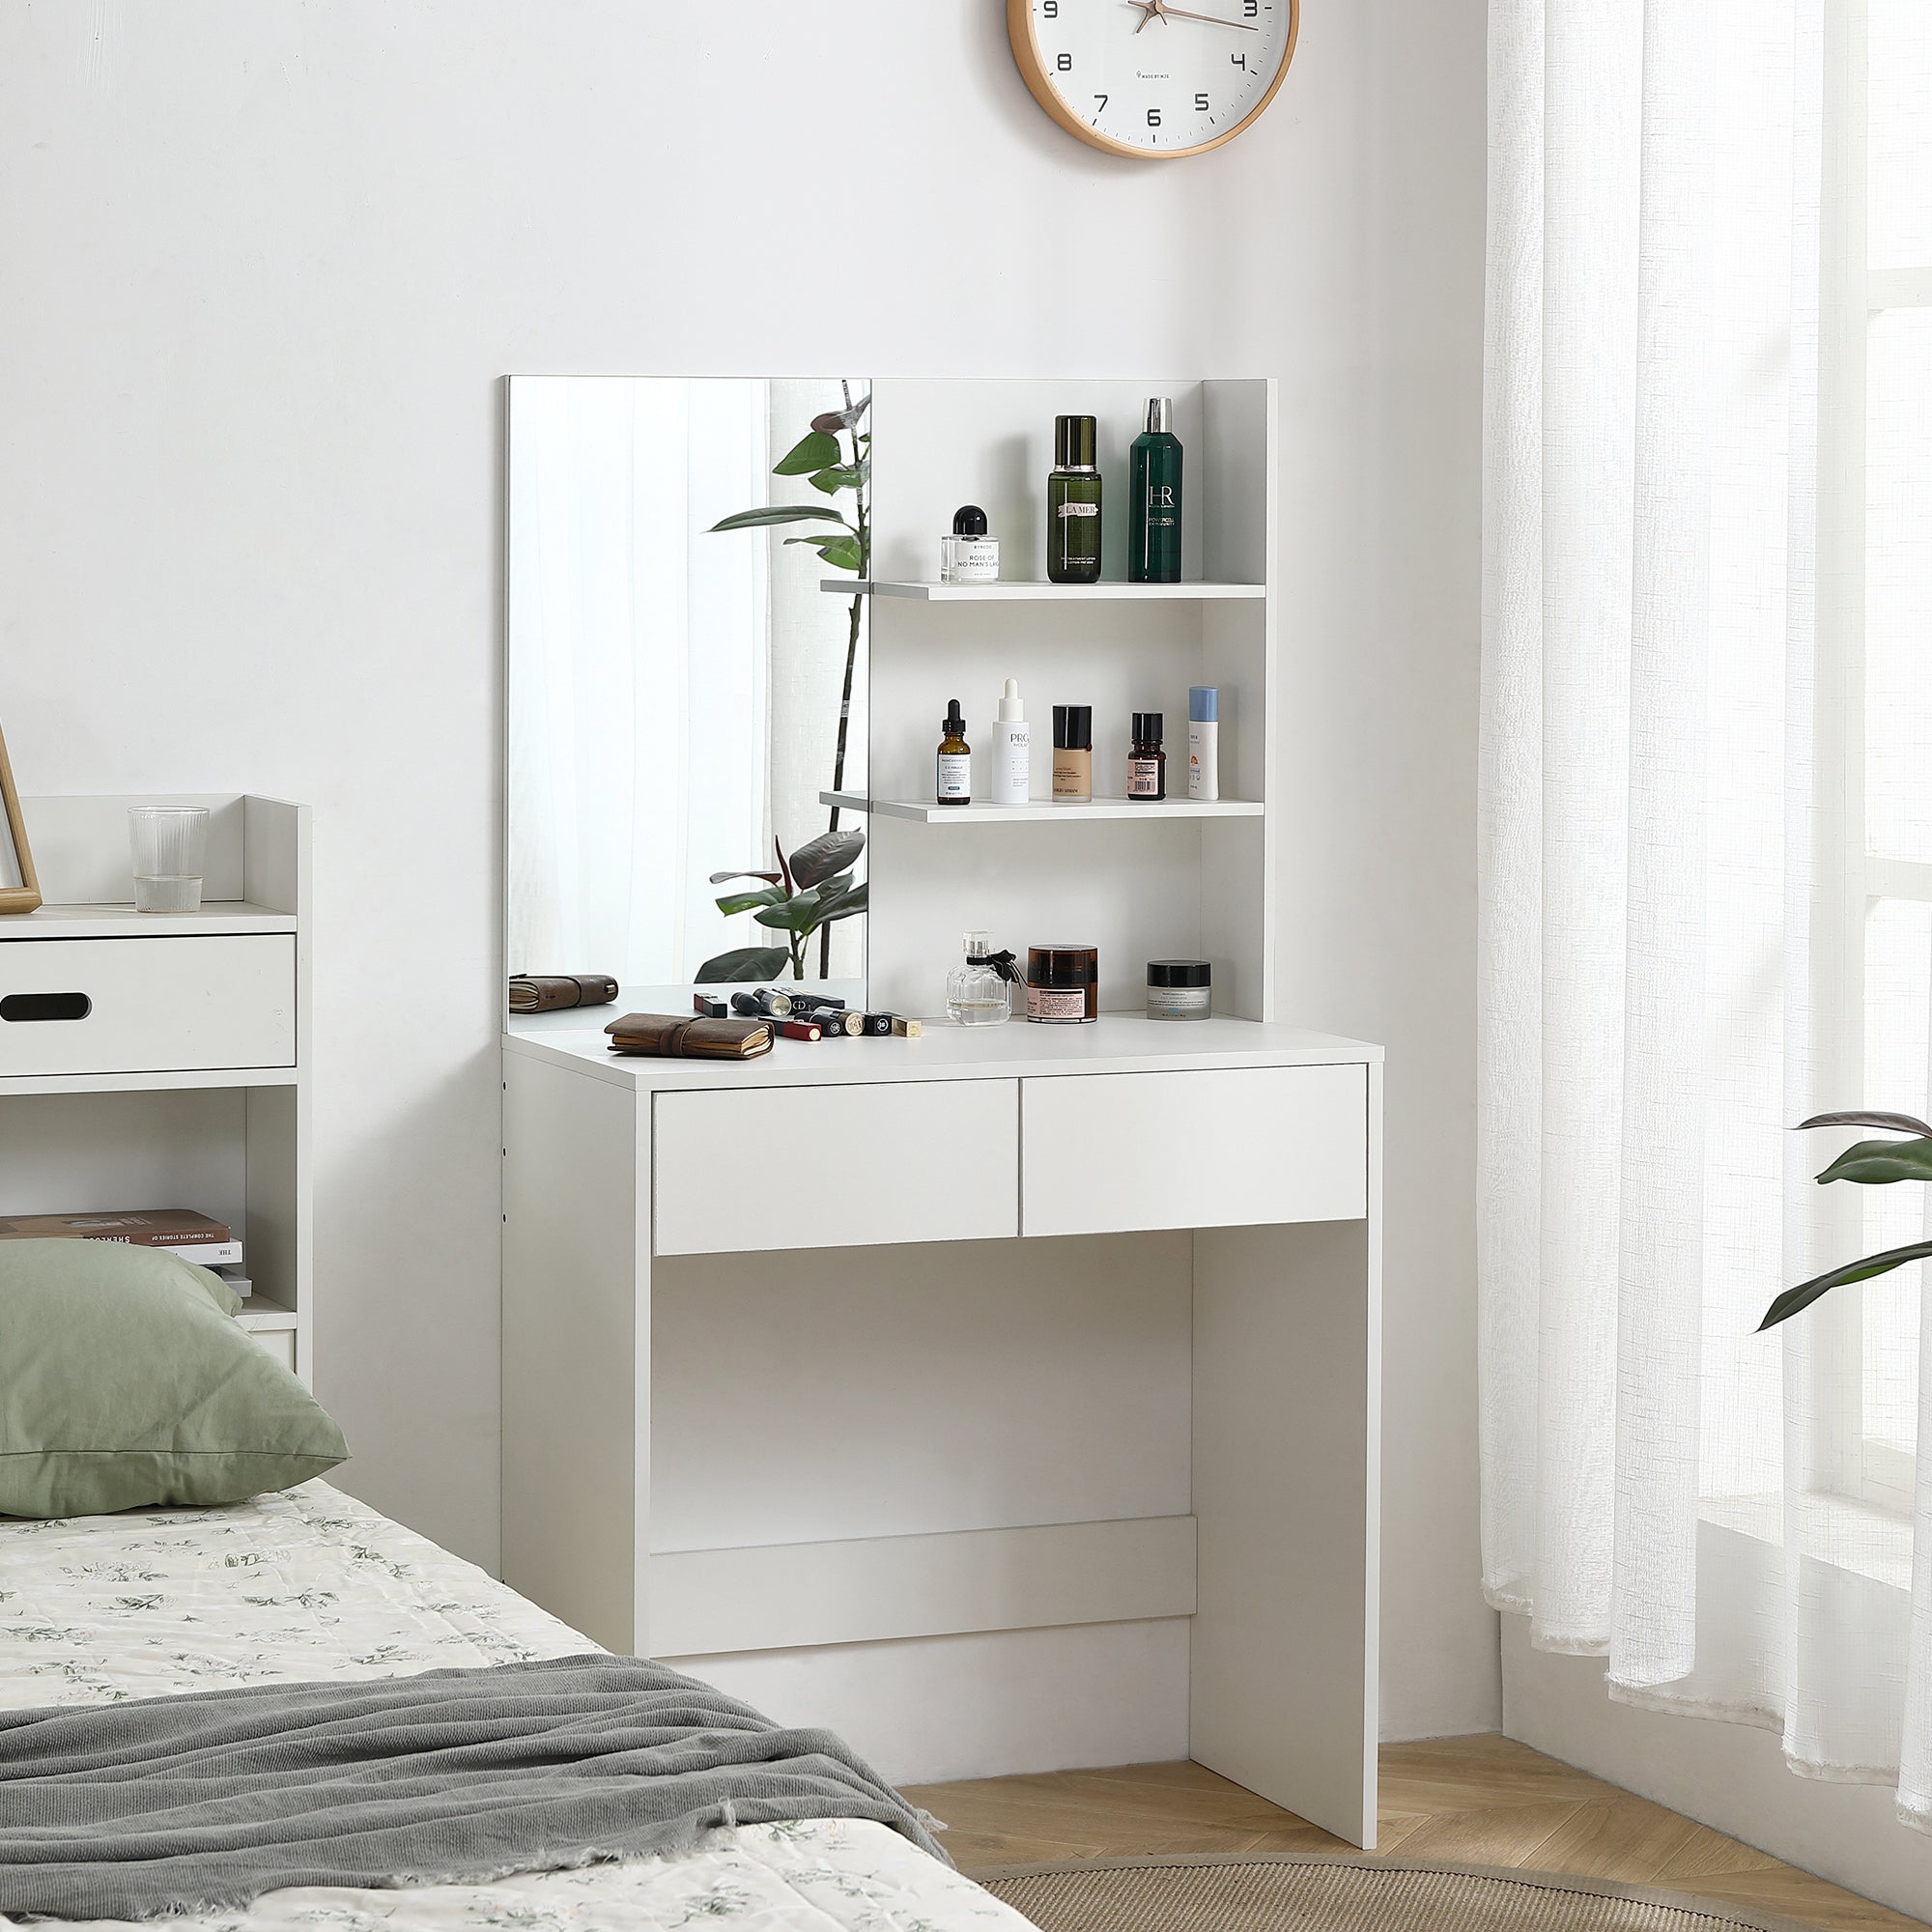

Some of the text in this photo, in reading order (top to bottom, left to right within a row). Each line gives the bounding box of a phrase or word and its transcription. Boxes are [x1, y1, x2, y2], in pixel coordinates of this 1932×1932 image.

[1043, 0, 1058, 18] 9
[1243, 0, 1258, 17] 3
[1057, 53, 1072, 71] 8
[1231, 53, 1245, 71] 4
[1094, 95, 1109, 112] 7
[1194, 93, 1209, 111] 5
[1147, 108, 1161, 127] 6
[1150, 485, 1175, 505] HR
[1078, 505, 1095, 514] MER
